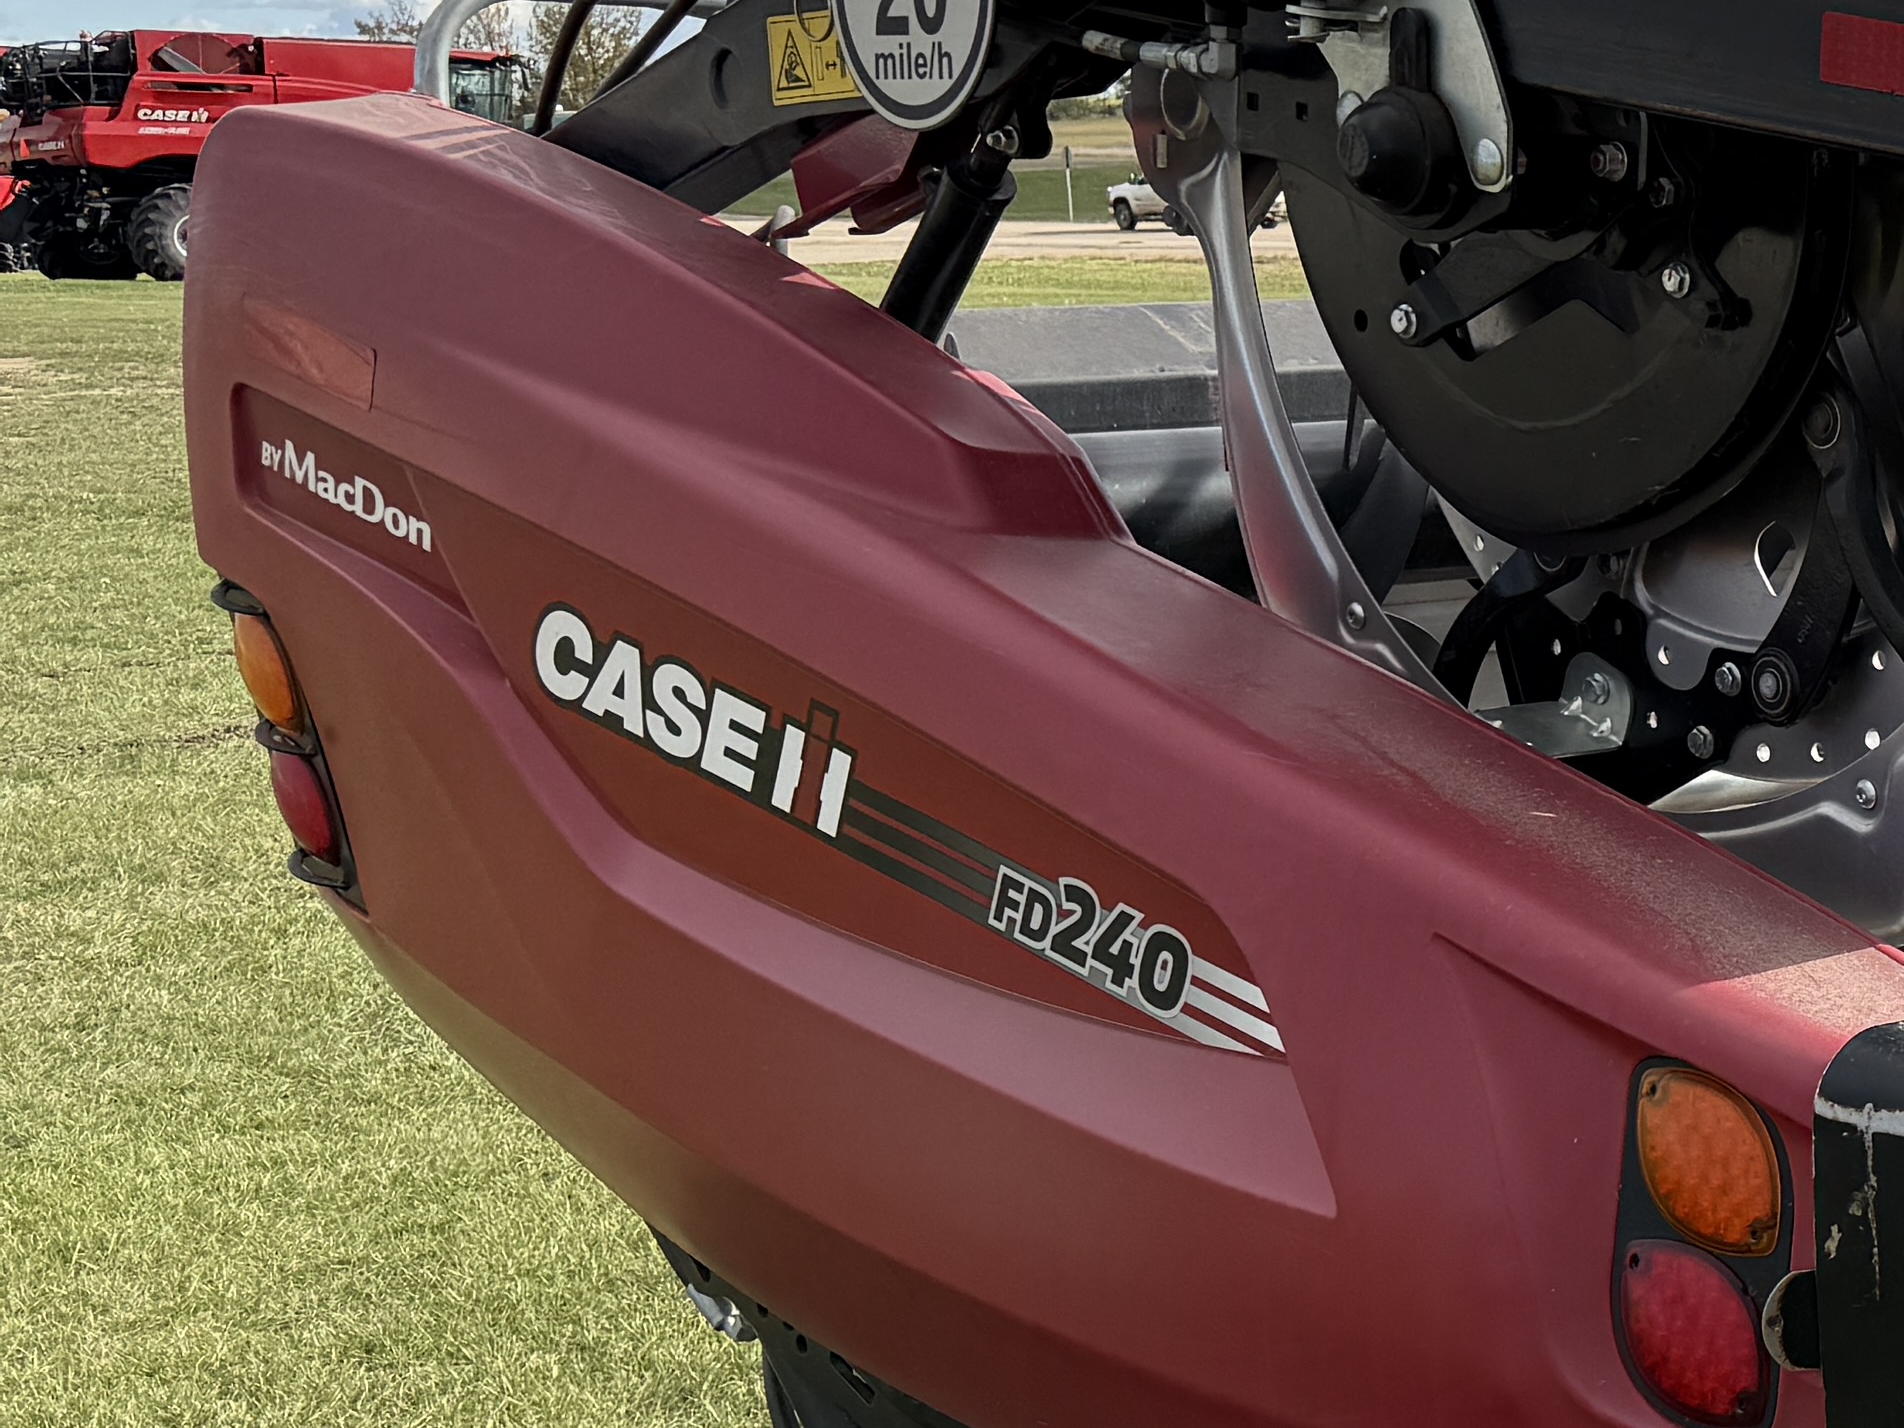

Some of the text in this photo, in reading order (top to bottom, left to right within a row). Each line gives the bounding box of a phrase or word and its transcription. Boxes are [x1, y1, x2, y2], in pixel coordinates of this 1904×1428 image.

[137, 108, 190, 122] CASE
[874, 41, 954, 81] mile/h
[261, 438, 432, 553] BY MacDon
[534, 609, 767, 793] CASE
[989, 866, 1193, 1017] FD240
